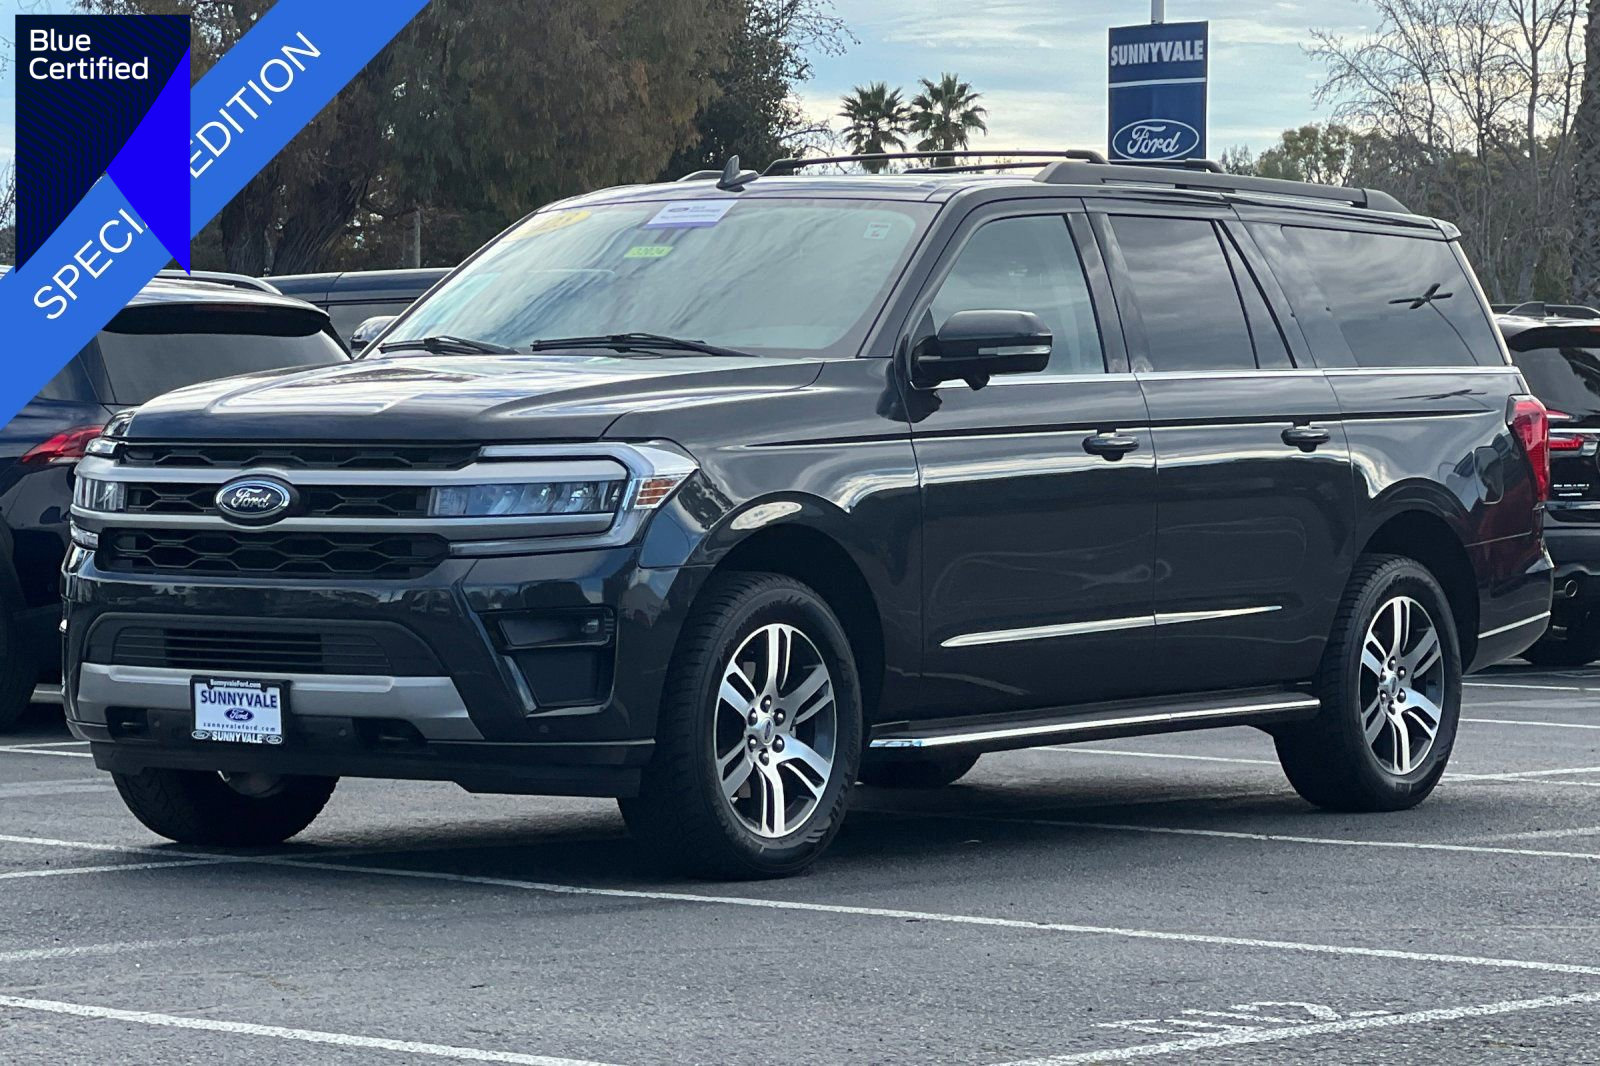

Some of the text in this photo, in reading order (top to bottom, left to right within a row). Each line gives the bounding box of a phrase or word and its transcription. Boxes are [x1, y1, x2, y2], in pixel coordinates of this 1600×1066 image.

[1110, 39, 1204, 66] SUNNYVALE
[1127, 125, 1182, 154] Ford
[231, 487, 271, 508] Ford
[201, 690, 277, 708] SUNNYVALE
[229, 710, 248, 720] Ford
[211, 731, 263, 743] SUNNYVALE
